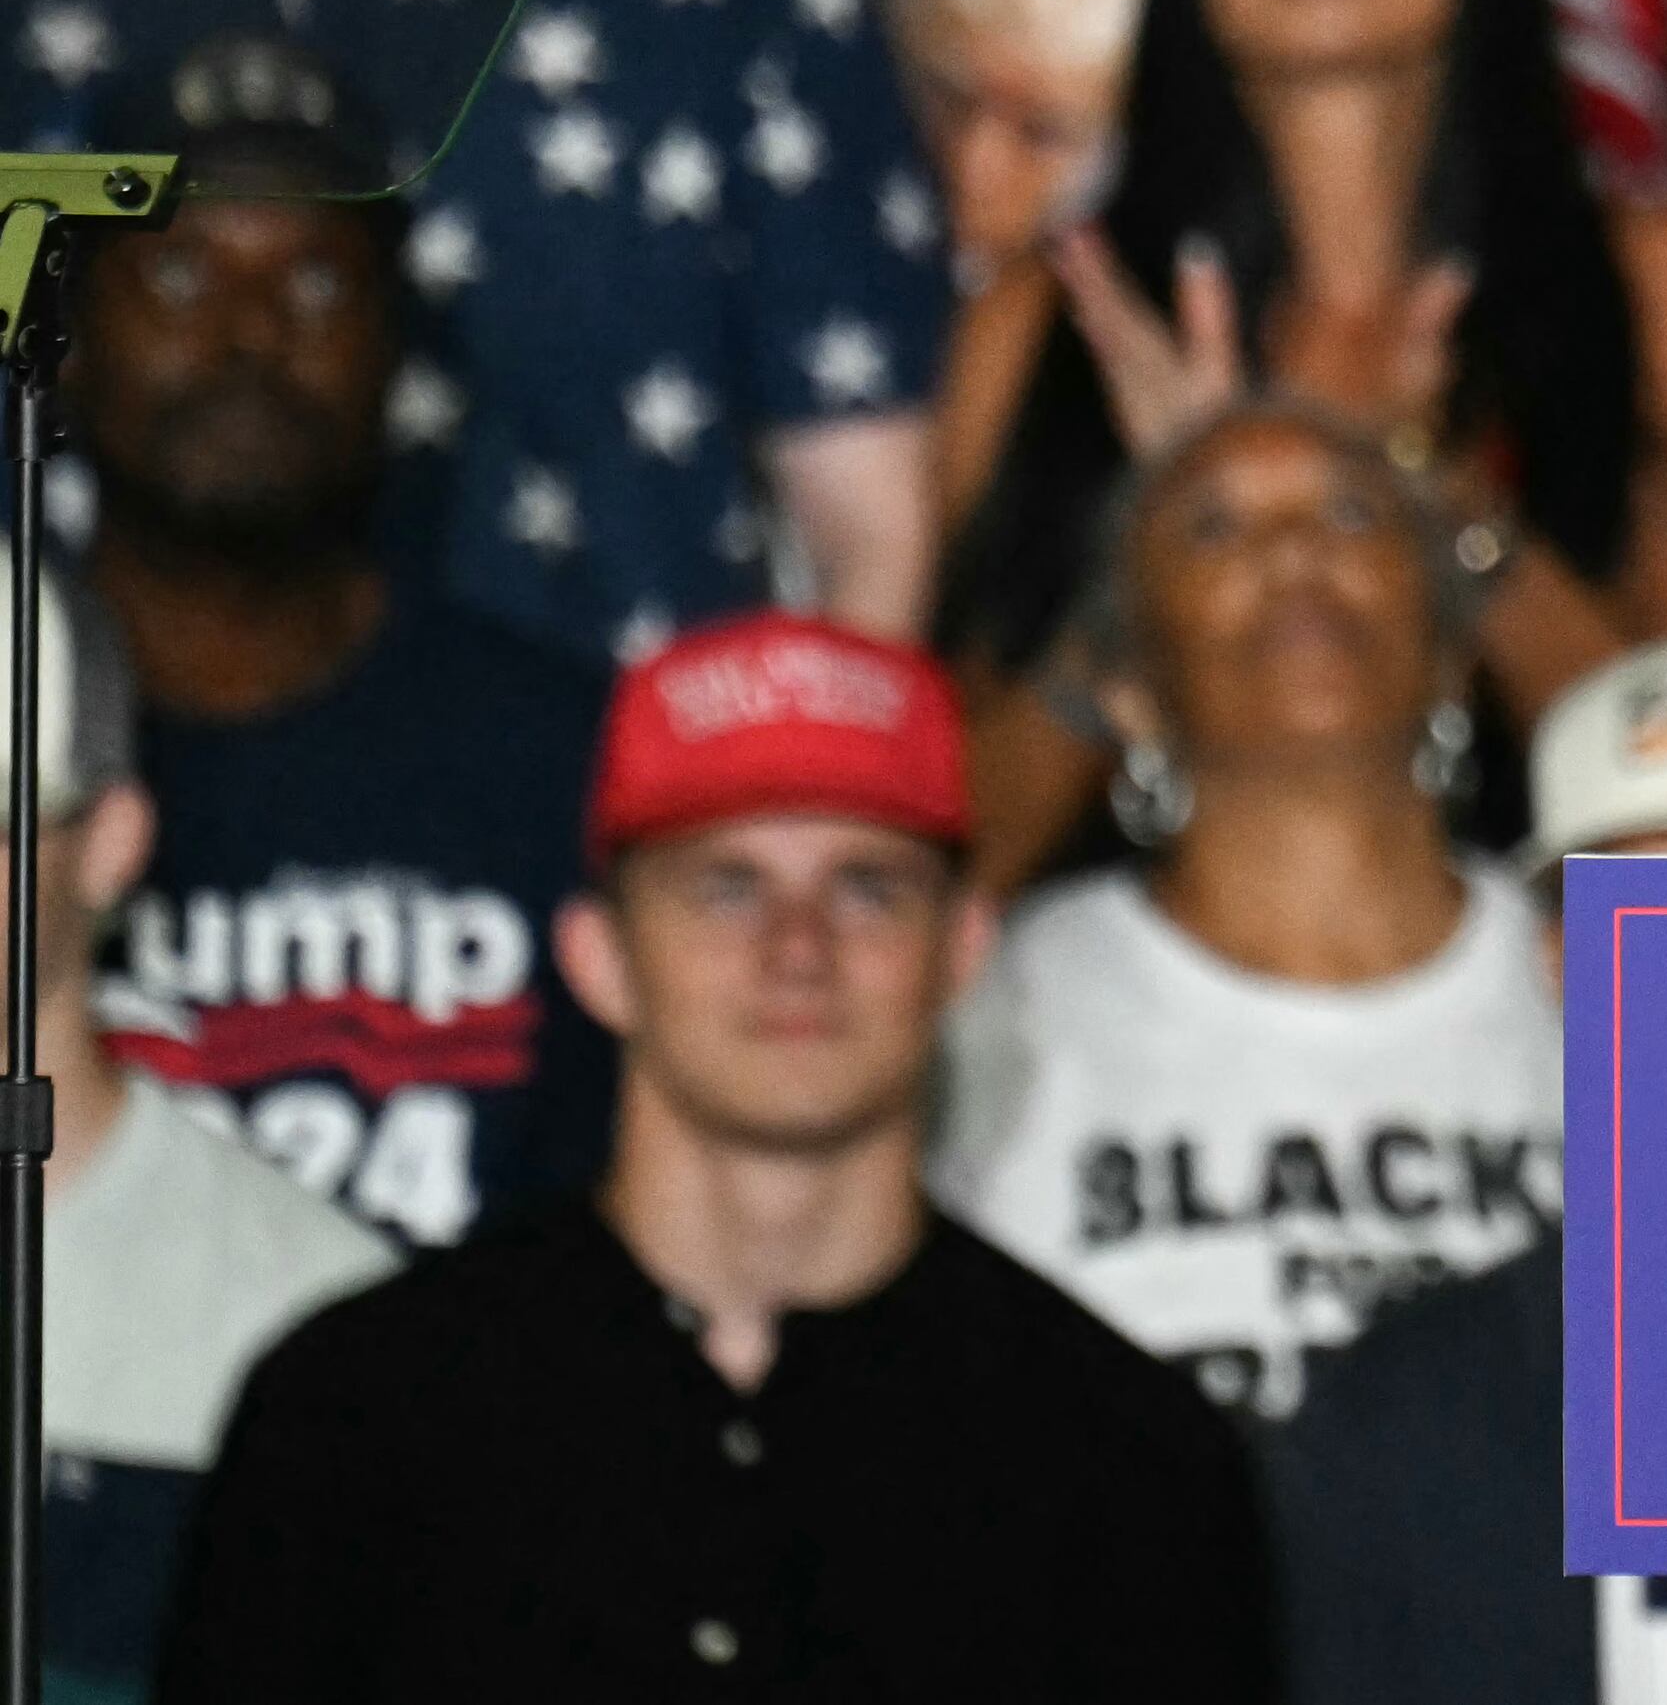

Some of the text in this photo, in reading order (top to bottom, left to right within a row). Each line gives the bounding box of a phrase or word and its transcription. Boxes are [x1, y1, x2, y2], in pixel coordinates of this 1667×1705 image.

[128, 880, 537, 1025] ump
[195, 1080, 480, 1247] 24
[1078, 1123, 1561, 1245] BLACK
